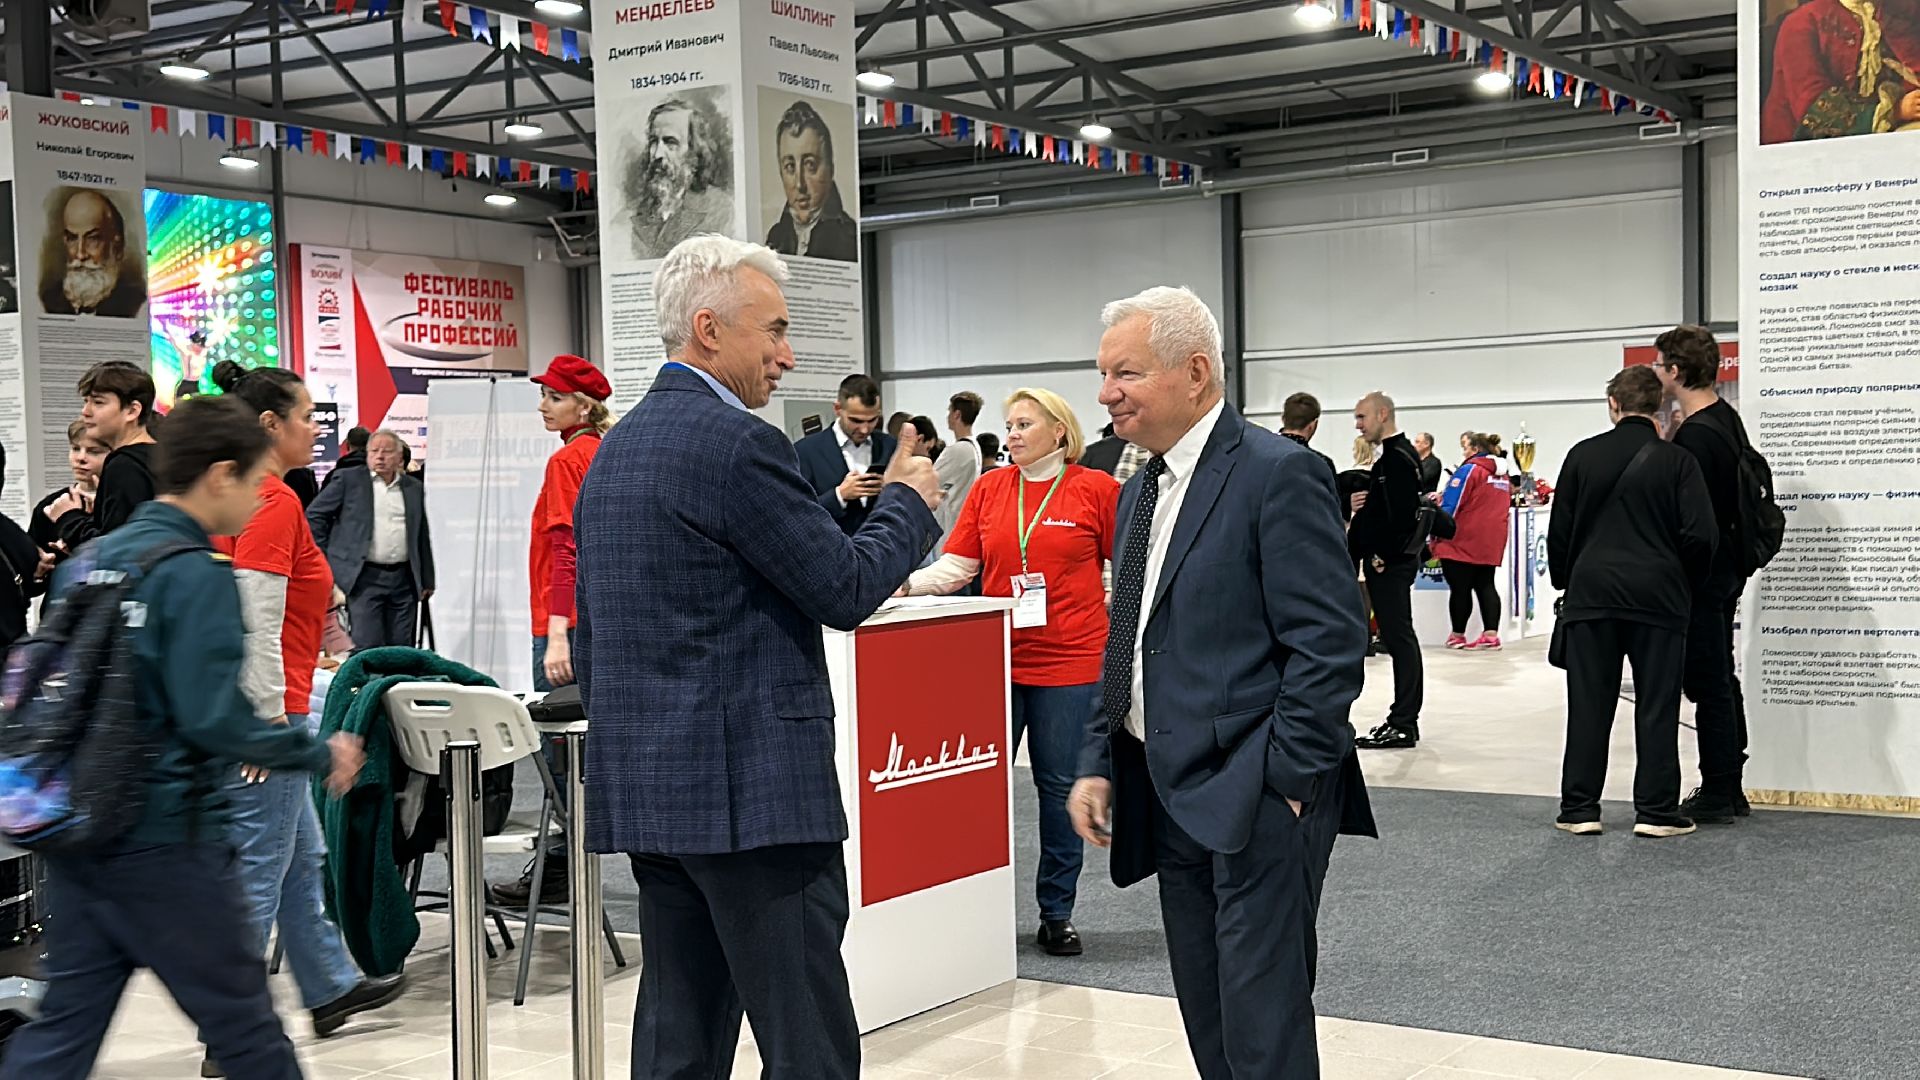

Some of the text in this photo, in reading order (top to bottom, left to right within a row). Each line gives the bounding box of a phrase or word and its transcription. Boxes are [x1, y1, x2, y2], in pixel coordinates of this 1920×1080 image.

[616, 0, 714, 24] МЕНДЕЛЕЕВ
[771, 0, 836, 28] ШИЛЛИНГ
[608, 33, 724, 60] Дмитрий Иванович
[770, 36, 839, 62] Павел Львович
[631, 71, 704, 89] 1834-1904 гг.
[778, 72, 832, 93] 1786-1837 гг.
[38, 113, 130, 136] ЖУКОВСКИЙ
[36, 142, 134, 160] Николай Егорович
[56, 170, 116, 184] 1847-1921 гг.
[1760, 178, 1918, 198] Открыл атмосферу у Венеры
[1813, 204, 1866, 214] произошло
[1802, 213, 1864, 225] прохождение
[1760, 229, 1806, 238] Наблюдая
[1802, 236, 1854, 244] Ломоносов
[1857, 232, 1893, 240] первым
[1869, 240, 1910, 249] оказался
[1760, 272, 1797, 280] Создал
[1800, 270, 1831, 278] науку
[1844, 266, 1880, 274] стекле
[404, 272, 513, 300] ФЕСТИВАЛЬ
[418, 298, 502, 322] РАБОЧИХ
[1760, 307, 1786, 315] Наука
[1823, 312, 1866, 321] областью
[1830, 321, 1882, 330] Ломоносов
[404, 323, 517, 347] ПРОФЕССИЙ
[1760, 334, 1823, 344] производства
[1808, 342, 1863, 352] уникальные
[1760, 355, 1789, 363] Одной
[1836, 350, 1892, 358] знаменитых
[1760, 386, 1863, 396] Объяснил природу
[1760, 421, 1831, 429] определившим
[1760, 430, 1827, 438] происходящее
[1844, 428, 1880, 436] воздухе
[1792, 438, 1856, 447] Современные
[1807, 458, 1839, 466] близко
[1848, 458, 1916, 466] определению
[1838, 491, 1870, 500] науку
[1825, 526, 1880, 534] физическая
[1762, 626, 1920, 637] Изобрел прототип вертолета
[1762, 649, 1818, 658] Ломоносову
[1860, 650, 1916, 659] разработать
[1814, 690, 1874, 698] Конструкция
[868, 731, 999, 784] Москвич
